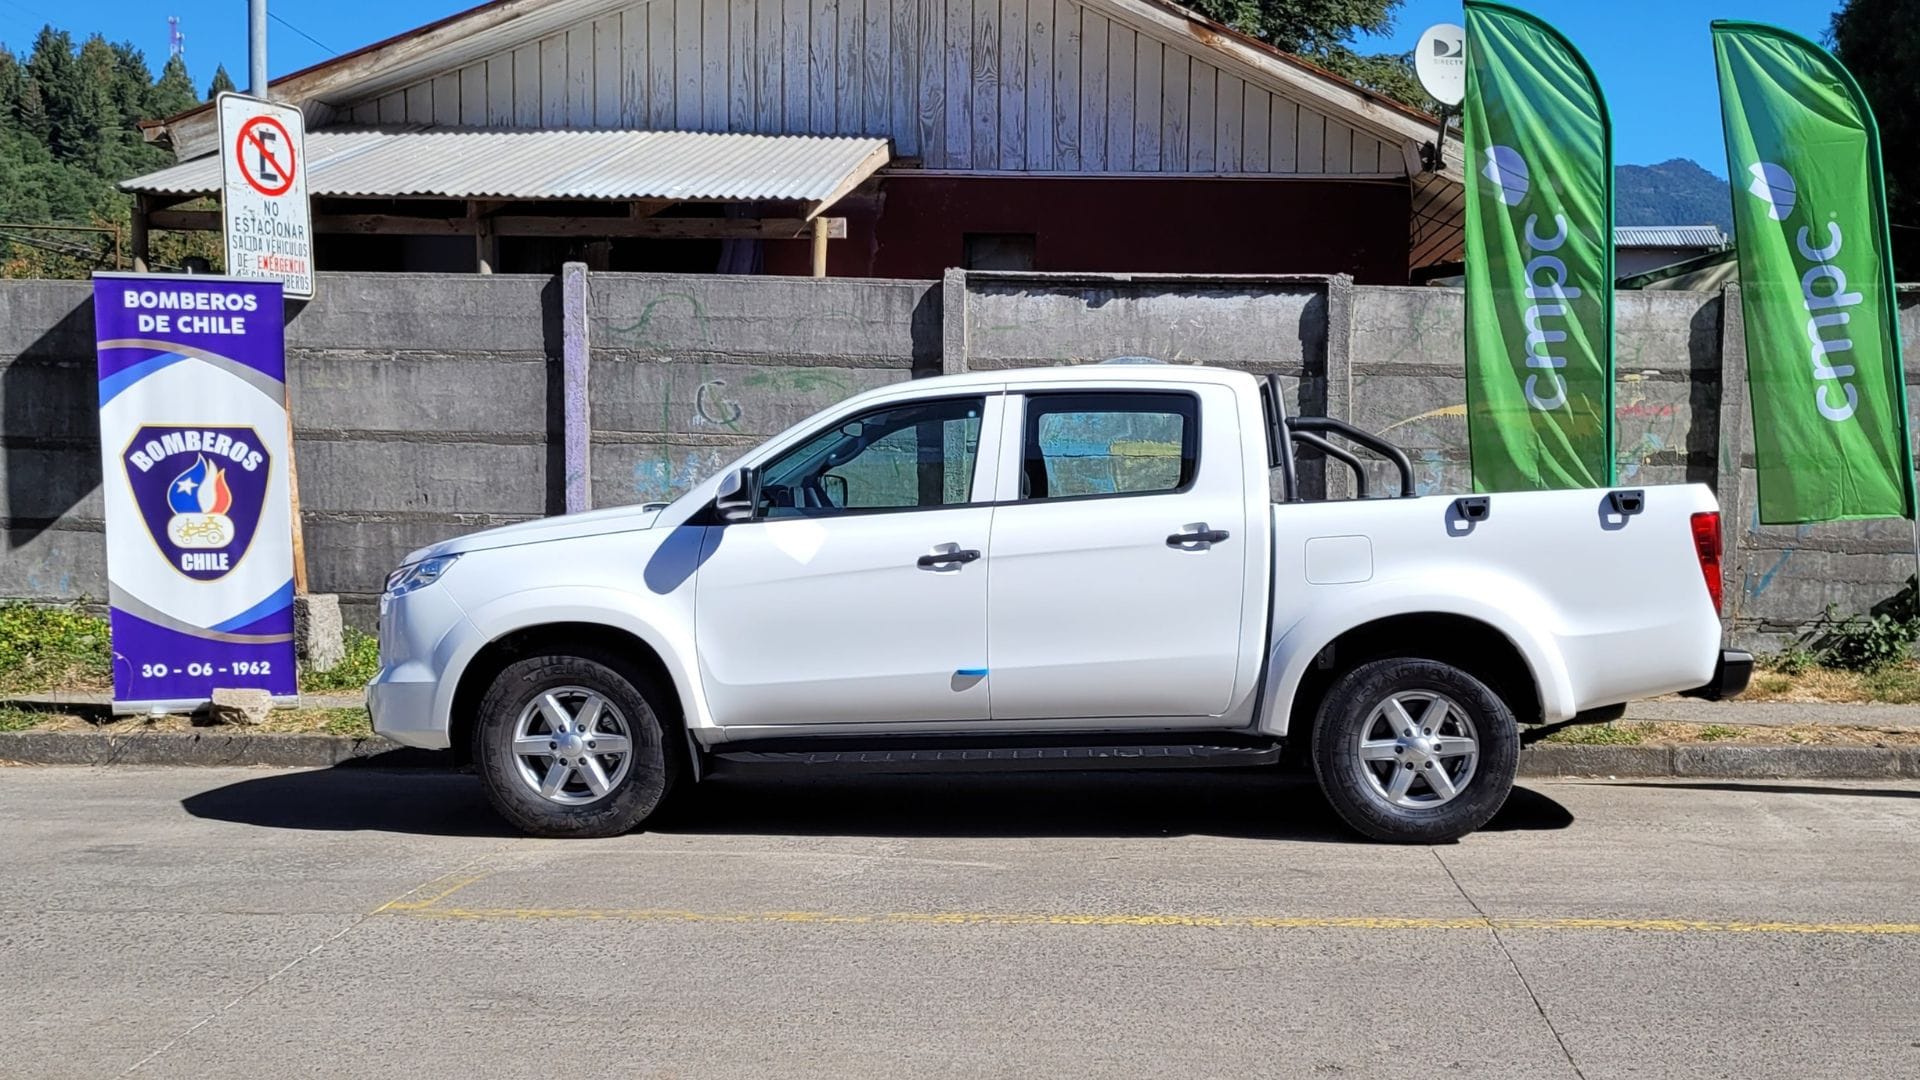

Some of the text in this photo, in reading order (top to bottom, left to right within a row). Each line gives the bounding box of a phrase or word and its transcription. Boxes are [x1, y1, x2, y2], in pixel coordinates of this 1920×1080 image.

[264, 200, 279, 217] NO
[235, 216, 304, 240] ESTACIONAR
[232, 235, 308, 257] SALIDA VEHICULOS
[237, 252, 248, 268] DE
[257, 254, 305, 274] EMERGENCIA
[123, 290, 258, 312] BOMBEROS
[1524, 213, 1582, 411] cmpc
[138, 314, 246, 335] DE CHILE
[1797, 221, 1863, 422] cmpc
[129, 430, 263, 473] BOMBEROS
[181, 552, 230, 571] CHILE
[142, 664, 168, 678] 30
[187, 663, 213, 676] 06
[231, 661, 271, 676] 1962
